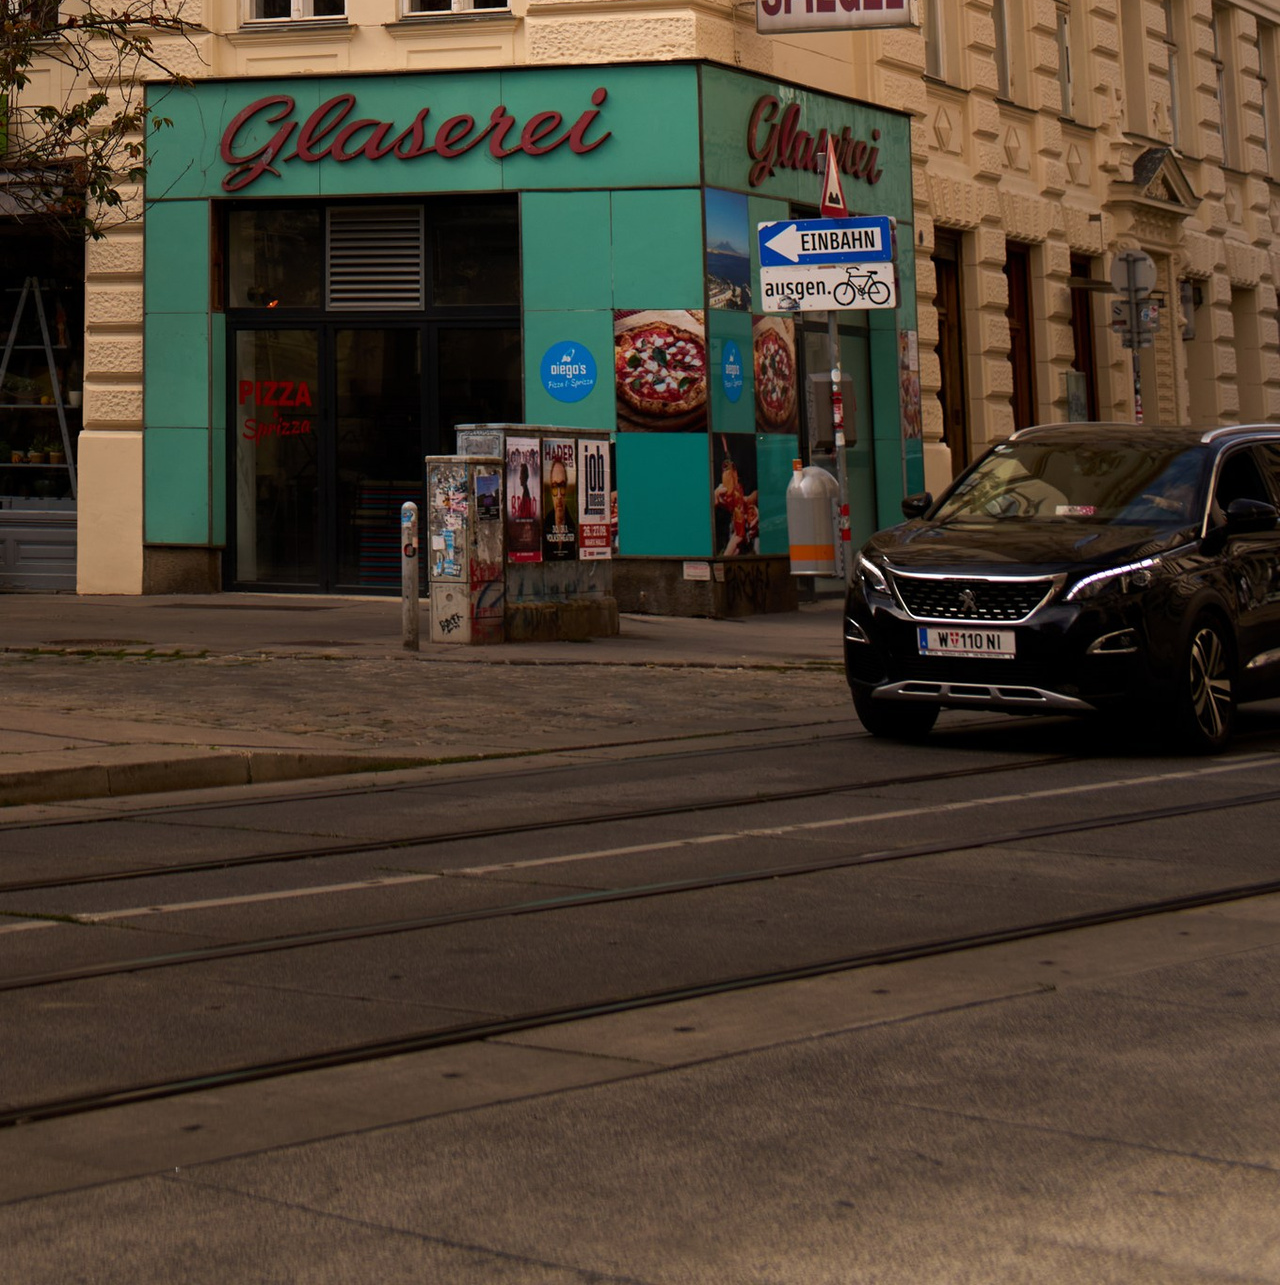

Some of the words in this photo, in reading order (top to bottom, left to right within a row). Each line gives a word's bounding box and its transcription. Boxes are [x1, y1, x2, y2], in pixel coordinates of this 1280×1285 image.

[219, 86, 612, 192] Glaserei
[801, 230, 876, 252] EINBAHN
[765, 280, 832, 300] ausgen.
[239, 380, 313, 407] PIZZA
[243, 417, 312, 447] Sprizza
[544, 444, 574, 461] HADER
[584, 445, 605, 515] job
[938, 632, 948, 648] W
[960, 632, 983, 649] 110
[987, 633, 1001, 650] NI
